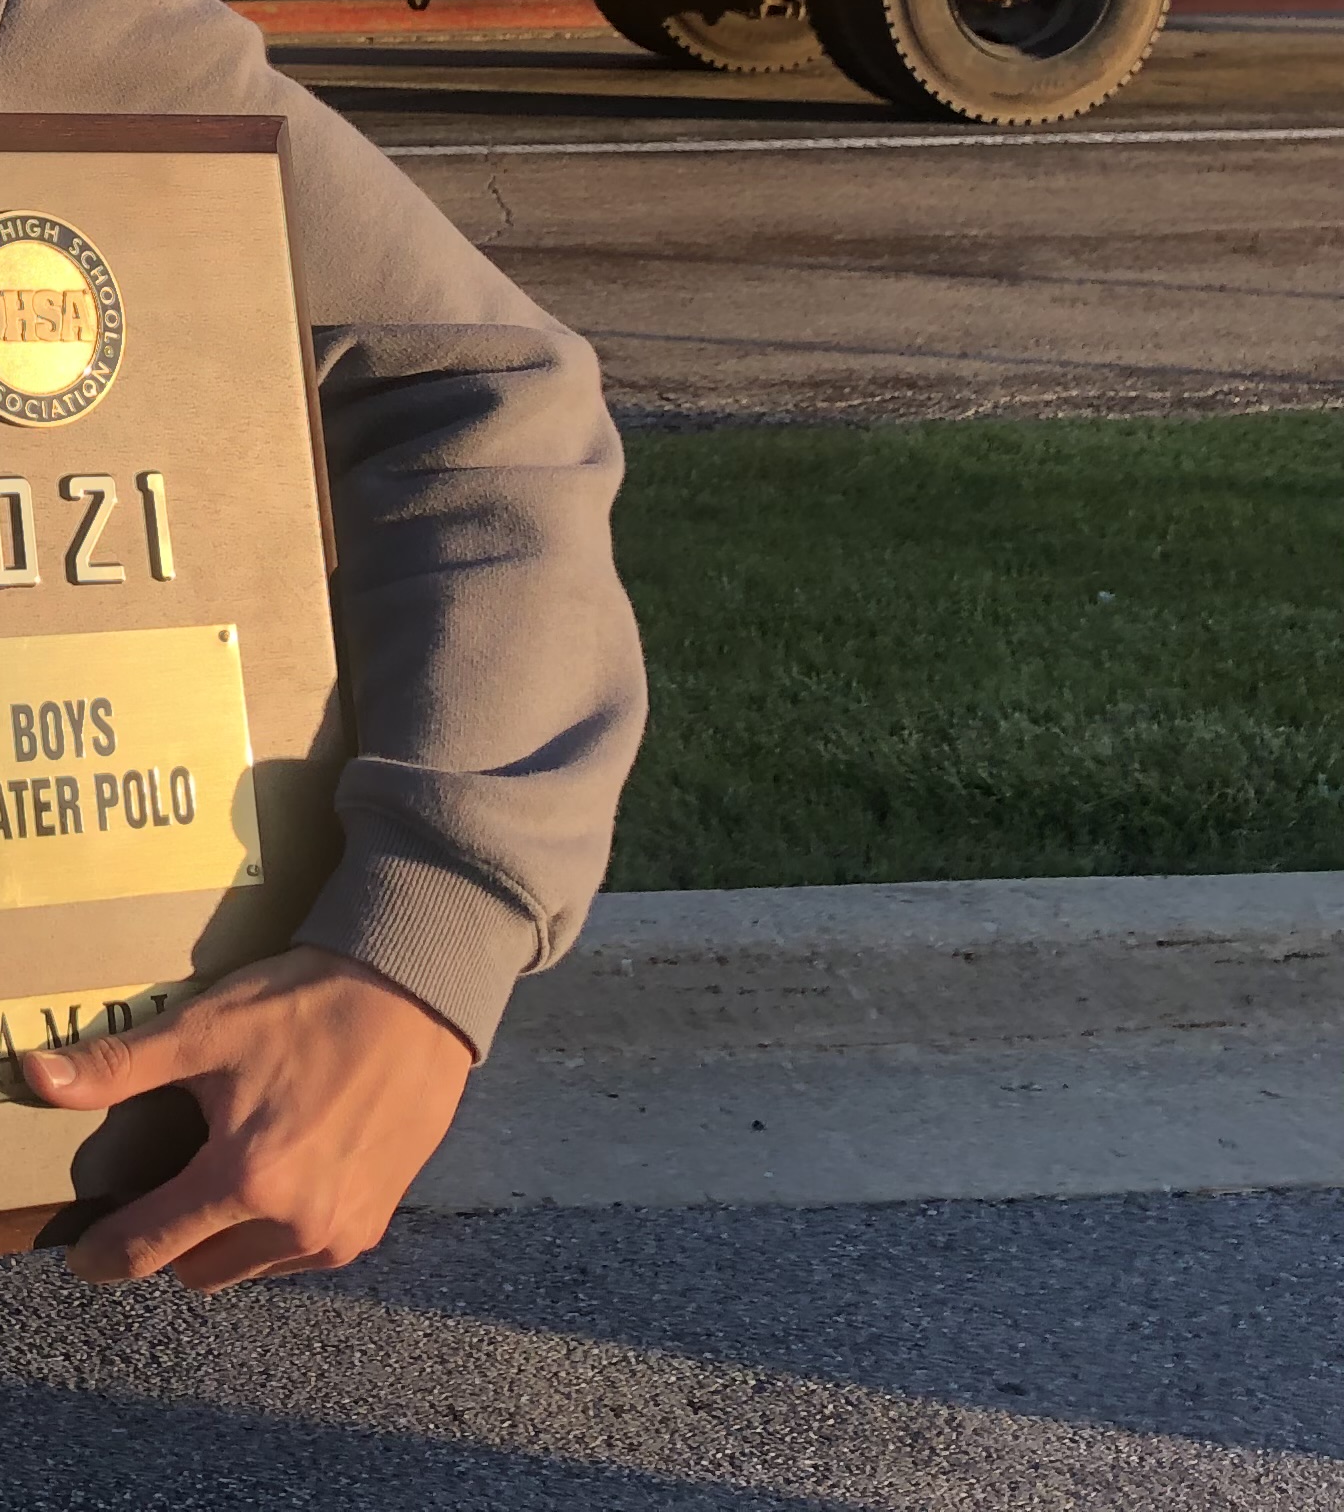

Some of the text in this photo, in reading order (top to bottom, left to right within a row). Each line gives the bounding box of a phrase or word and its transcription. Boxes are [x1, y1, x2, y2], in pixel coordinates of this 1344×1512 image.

[68, 237, 121, 343] SCHOOL
[11, 696, 117, 763] BOYS
[94, 765, 196, 835] POLO
